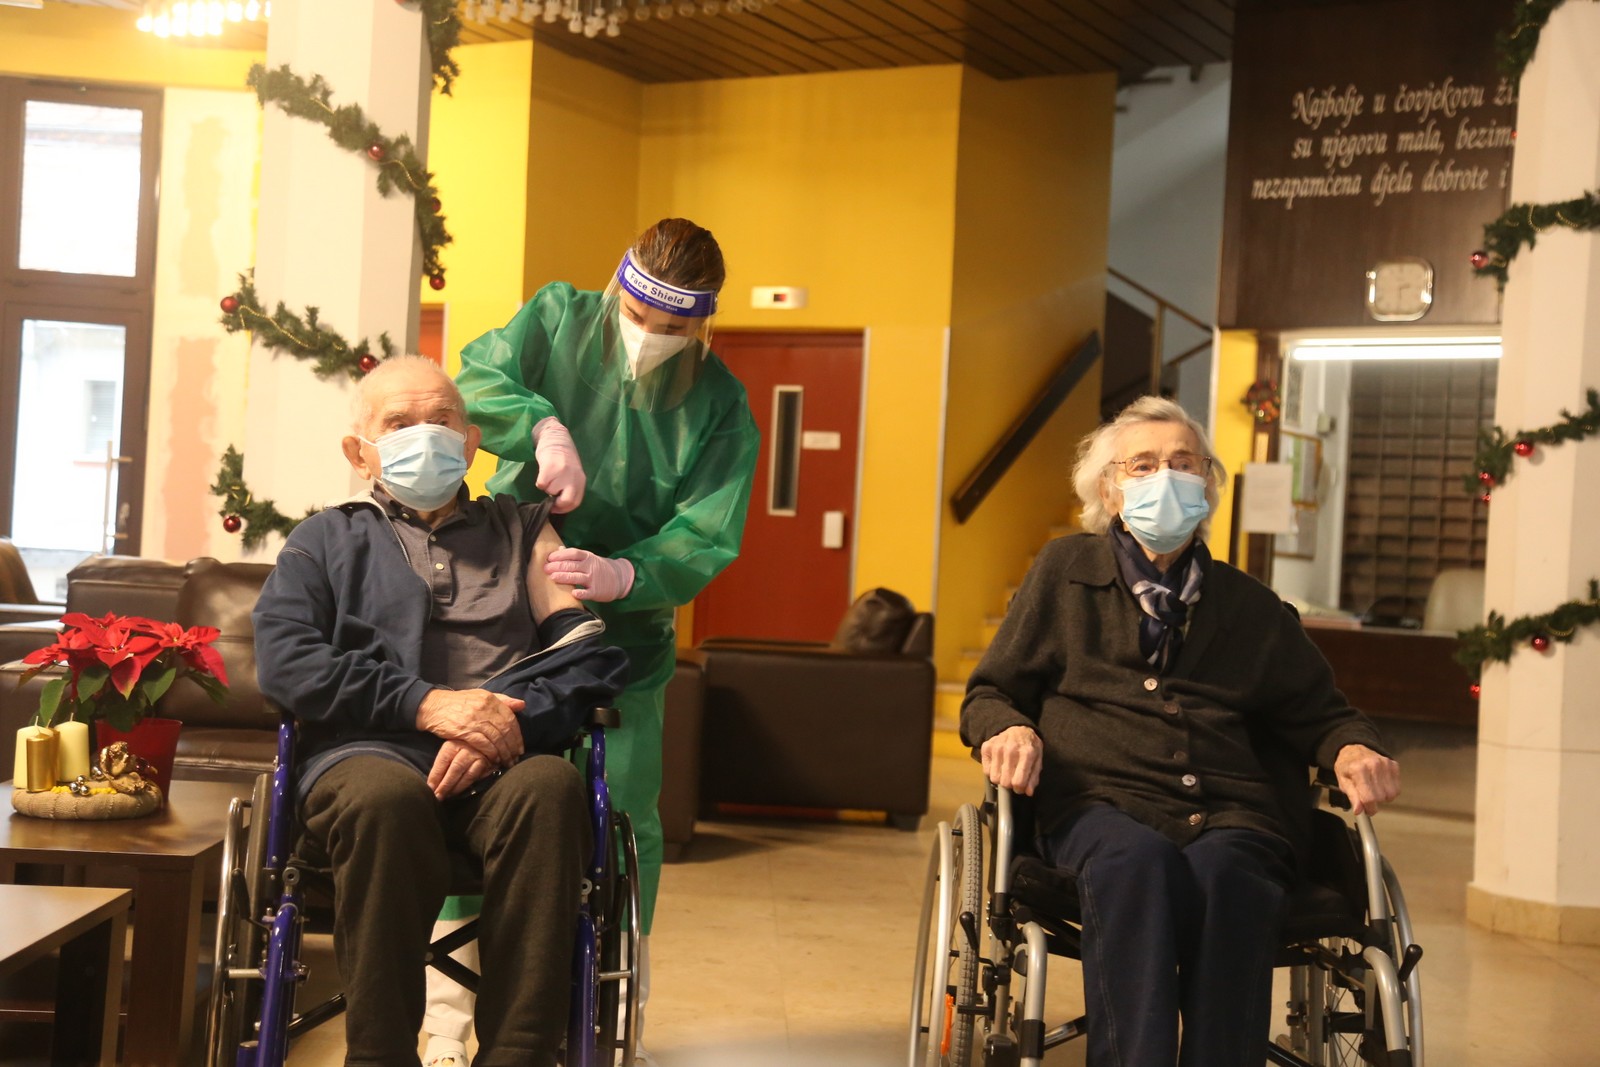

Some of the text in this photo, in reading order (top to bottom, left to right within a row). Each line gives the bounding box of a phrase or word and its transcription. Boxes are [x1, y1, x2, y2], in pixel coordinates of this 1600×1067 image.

[1291, 76, 1518, 130] Najbolje u čovjekovu ži
[1292, 117, 1515, 168] su njegova mala, bezim
[1370, 161, 1413, 207] djela
[1421, 159, 1488, 193] dobrote
[1499, 162, 1510, 188] i
[630, 273, 648, 291] Face
[650, 287, 684, 305] Shield
